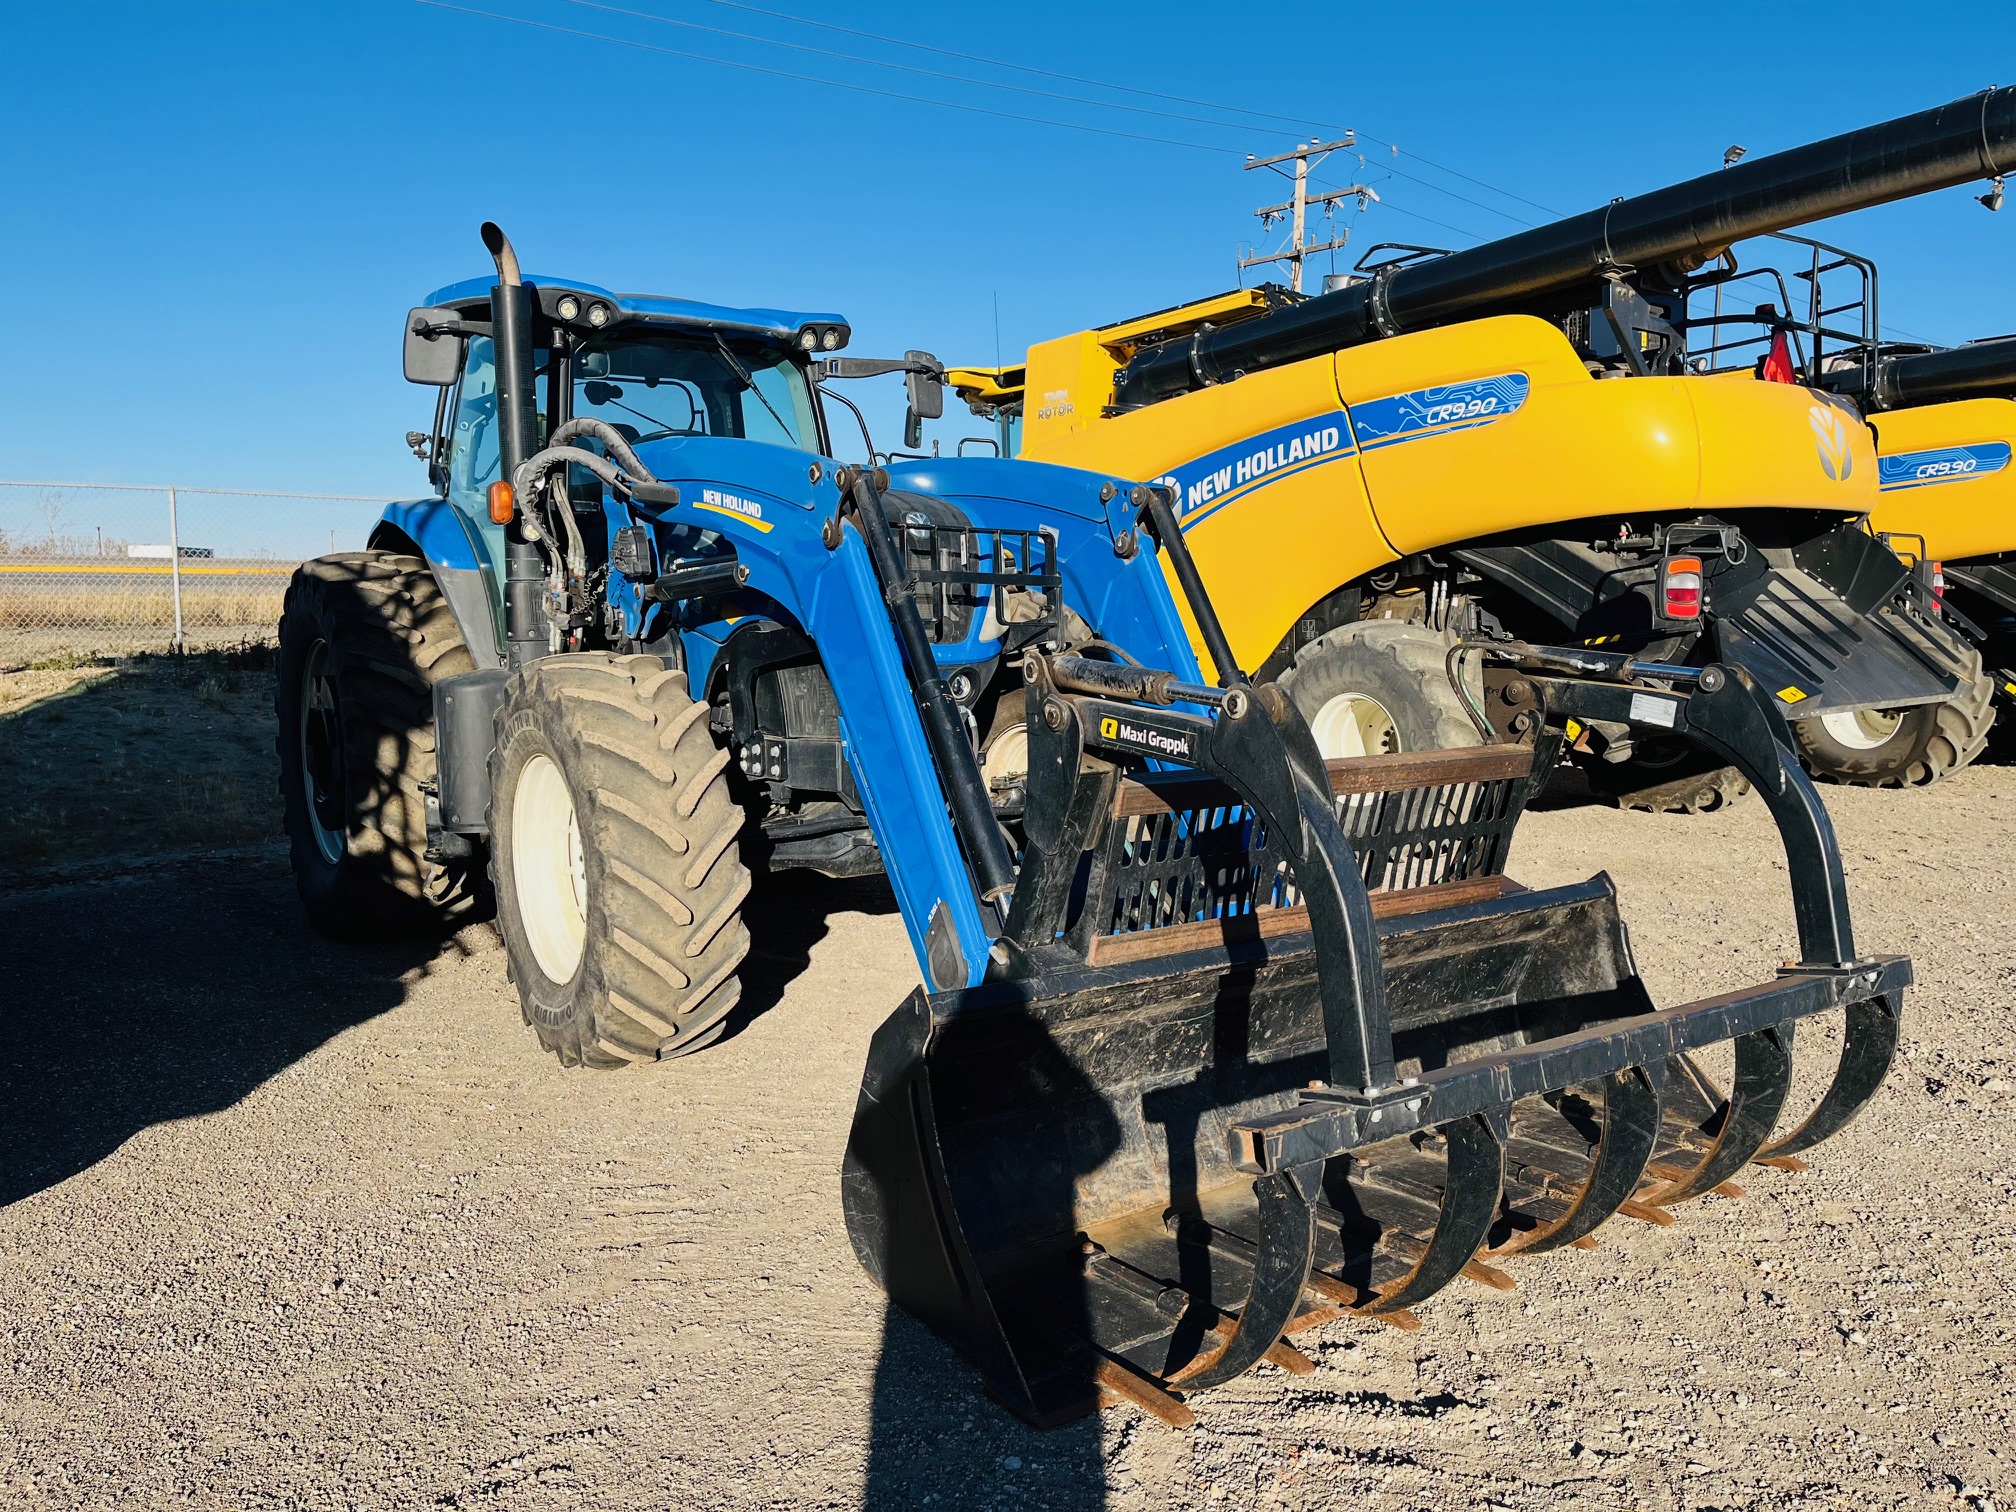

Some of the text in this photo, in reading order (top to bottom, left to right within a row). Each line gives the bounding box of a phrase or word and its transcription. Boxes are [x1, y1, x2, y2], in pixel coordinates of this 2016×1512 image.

[1043, 389, 1068, 403] TWIN
[1037, 403, 1074, 420] ROTOR
[1427, 397, 1499, 424] CR9.90
[1188, 427, 1339, 510] NEW HOLLAND
[1916, 459, 1977, 478] CR9.90
[703, 489, 762, 518] NEW HOLLAND
[1120, 723, 1147, 744] Maxi
